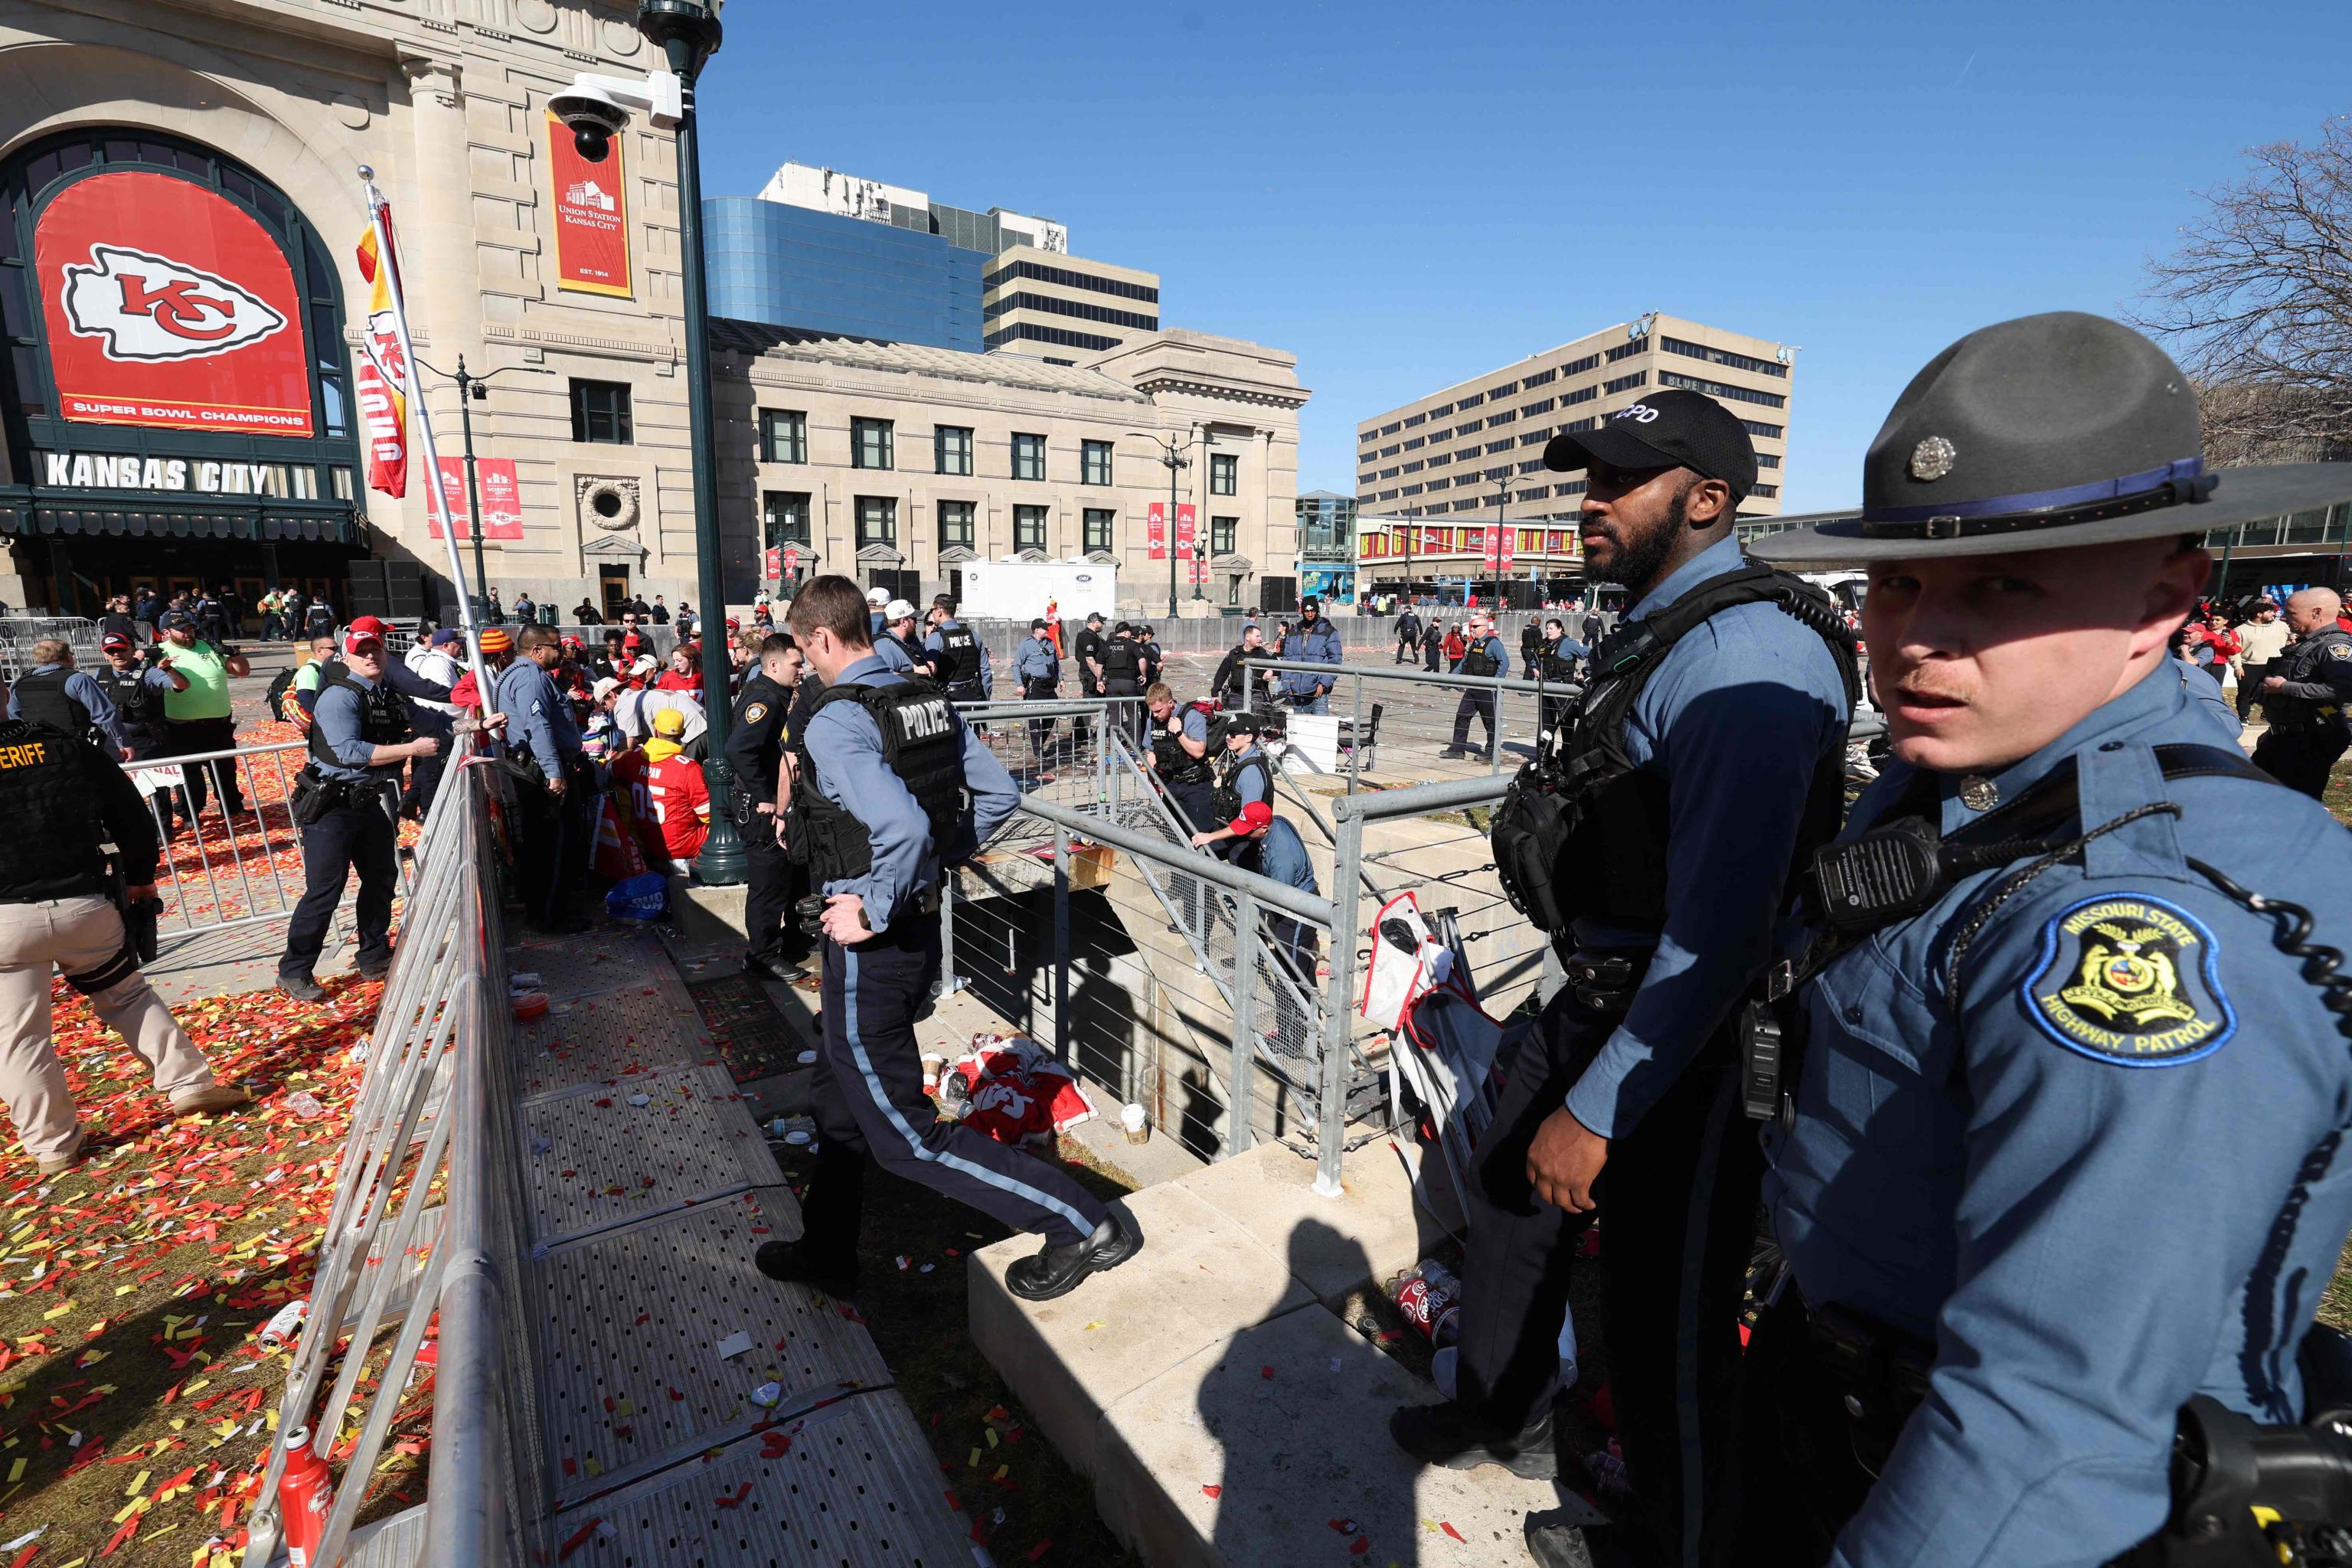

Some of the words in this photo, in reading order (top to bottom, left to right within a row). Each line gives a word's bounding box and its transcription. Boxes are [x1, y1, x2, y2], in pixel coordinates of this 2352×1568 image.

[565, 214, 596, 227] KANSAS
[597, 220, 616, 230] CITY
[587, 210, 621, 223] STATION
[580, 267, 594, 276] EST.
[595, 270, 609, 278] 1914
[114, 273, 237, 341] KC
[1668, 375, 1697, 391] BLUE
[1705, 384, 1720, 395] KC
[73, 402, 137, 416] SUPER
[142, 407, 197, 420] BOWL
[201, 410, 305, 426] CHAMPIONS
[1612, 404, 1658, 423] CPD
[47, 453, 186, 490] KANSAS
[200, 462, 268, 495] CITY
[1517, 531, 1542, 551] CK
[897, 699, 950, 740] POLICE
[0, 743, 45, 769] ERIFF
[639, 766, 662, 779] PAPAW
[632, 782, 666, 825] 05
[1841, 852, 1854, 892] MOTOROLA
[2063, 903, 2145, 935] MISSOURI
[2145, 909, 2199, 947] STATE
[2041, 995, 2125, 1050] HIGHWAY
[2135, 1018, 2216, 1052] PATROL
